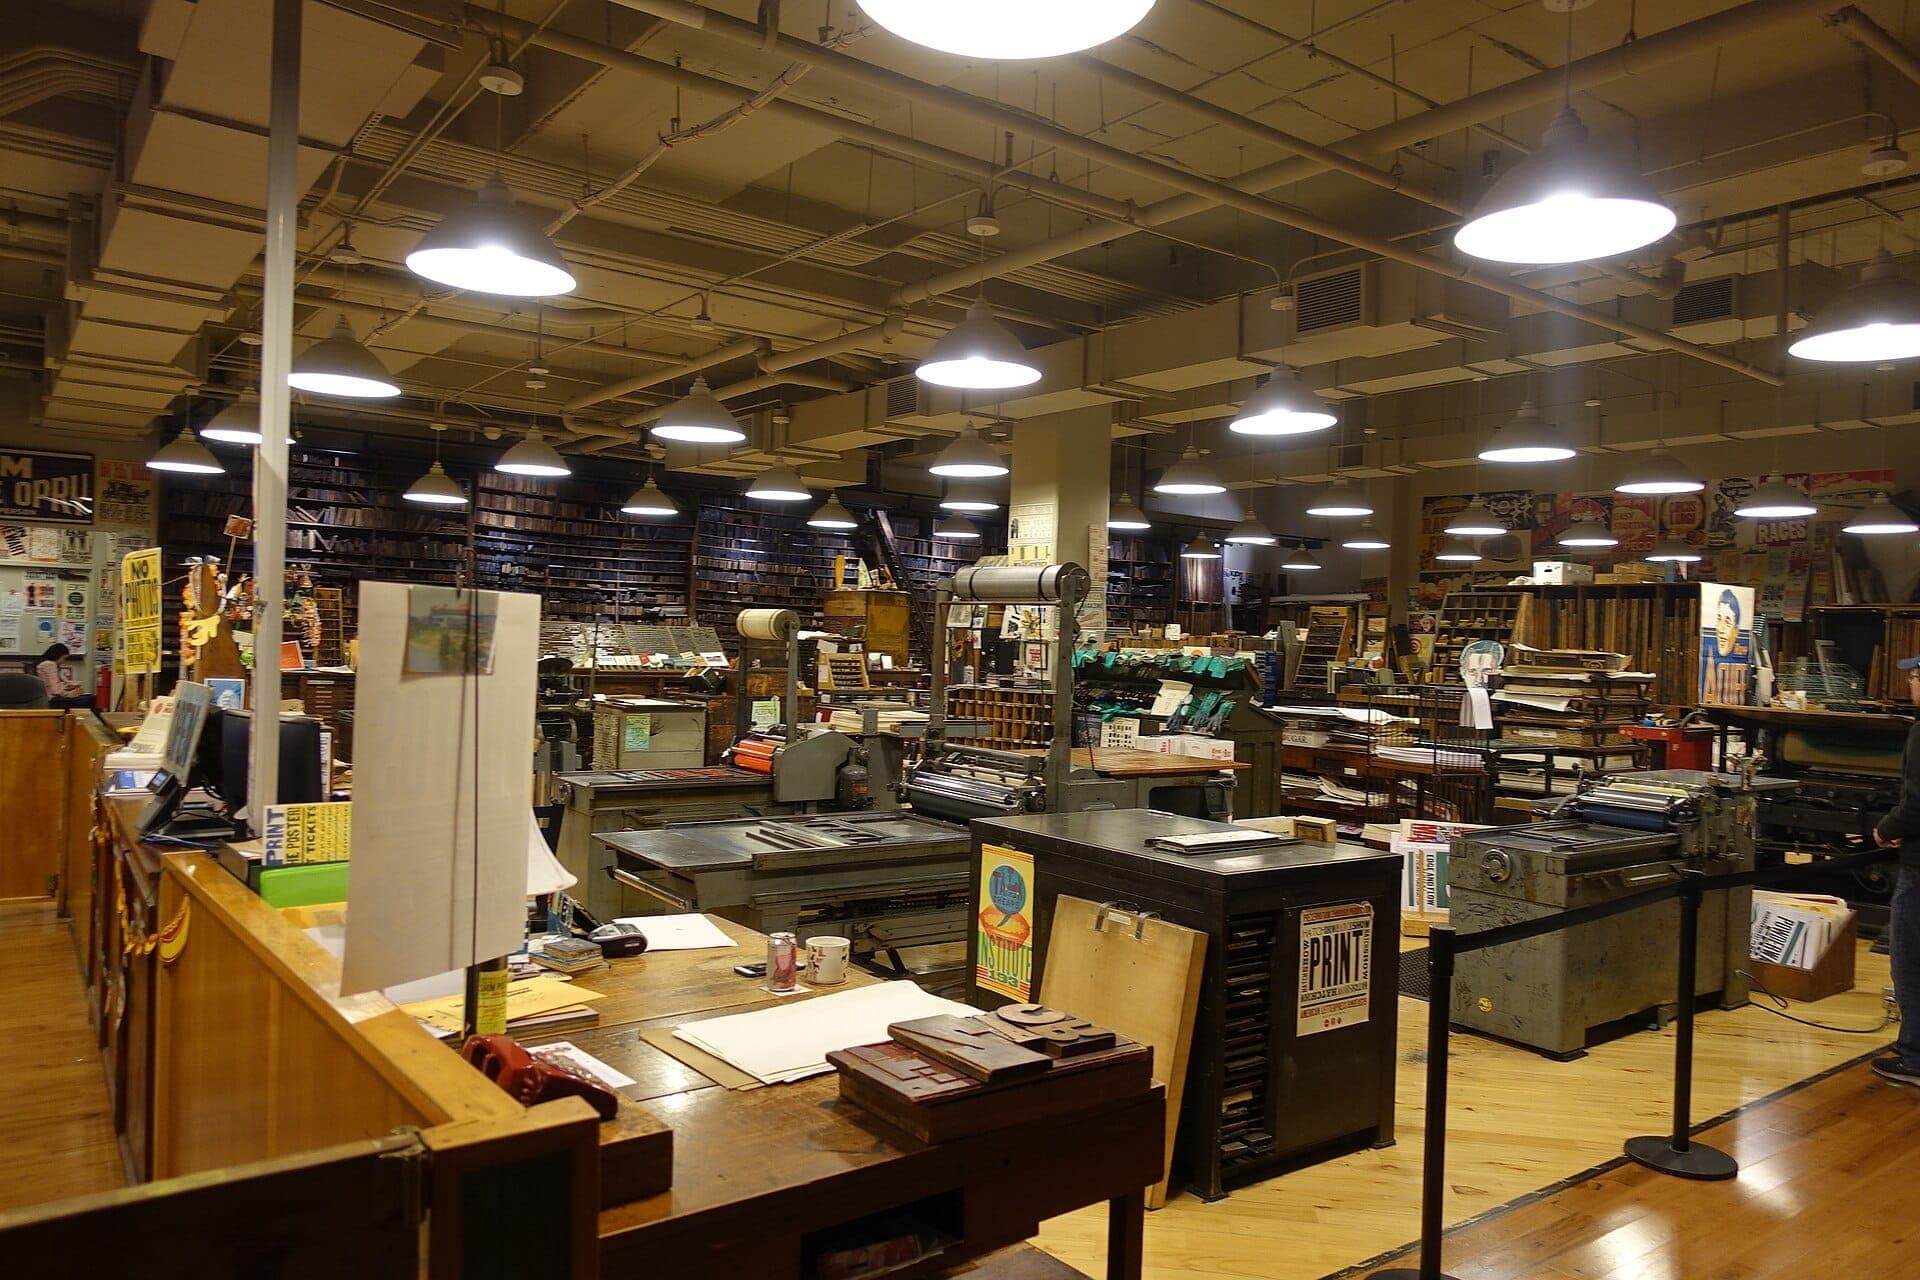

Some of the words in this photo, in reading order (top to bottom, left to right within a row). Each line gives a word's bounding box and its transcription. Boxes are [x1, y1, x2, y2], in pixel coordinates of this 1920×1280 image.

[1757, 519, 1808, 544] RACES
[266, 808, 284, 867] PRINT
[306, 806, 317, 853] TICKETS
[1308, 929, 1364, 991] PRINT
